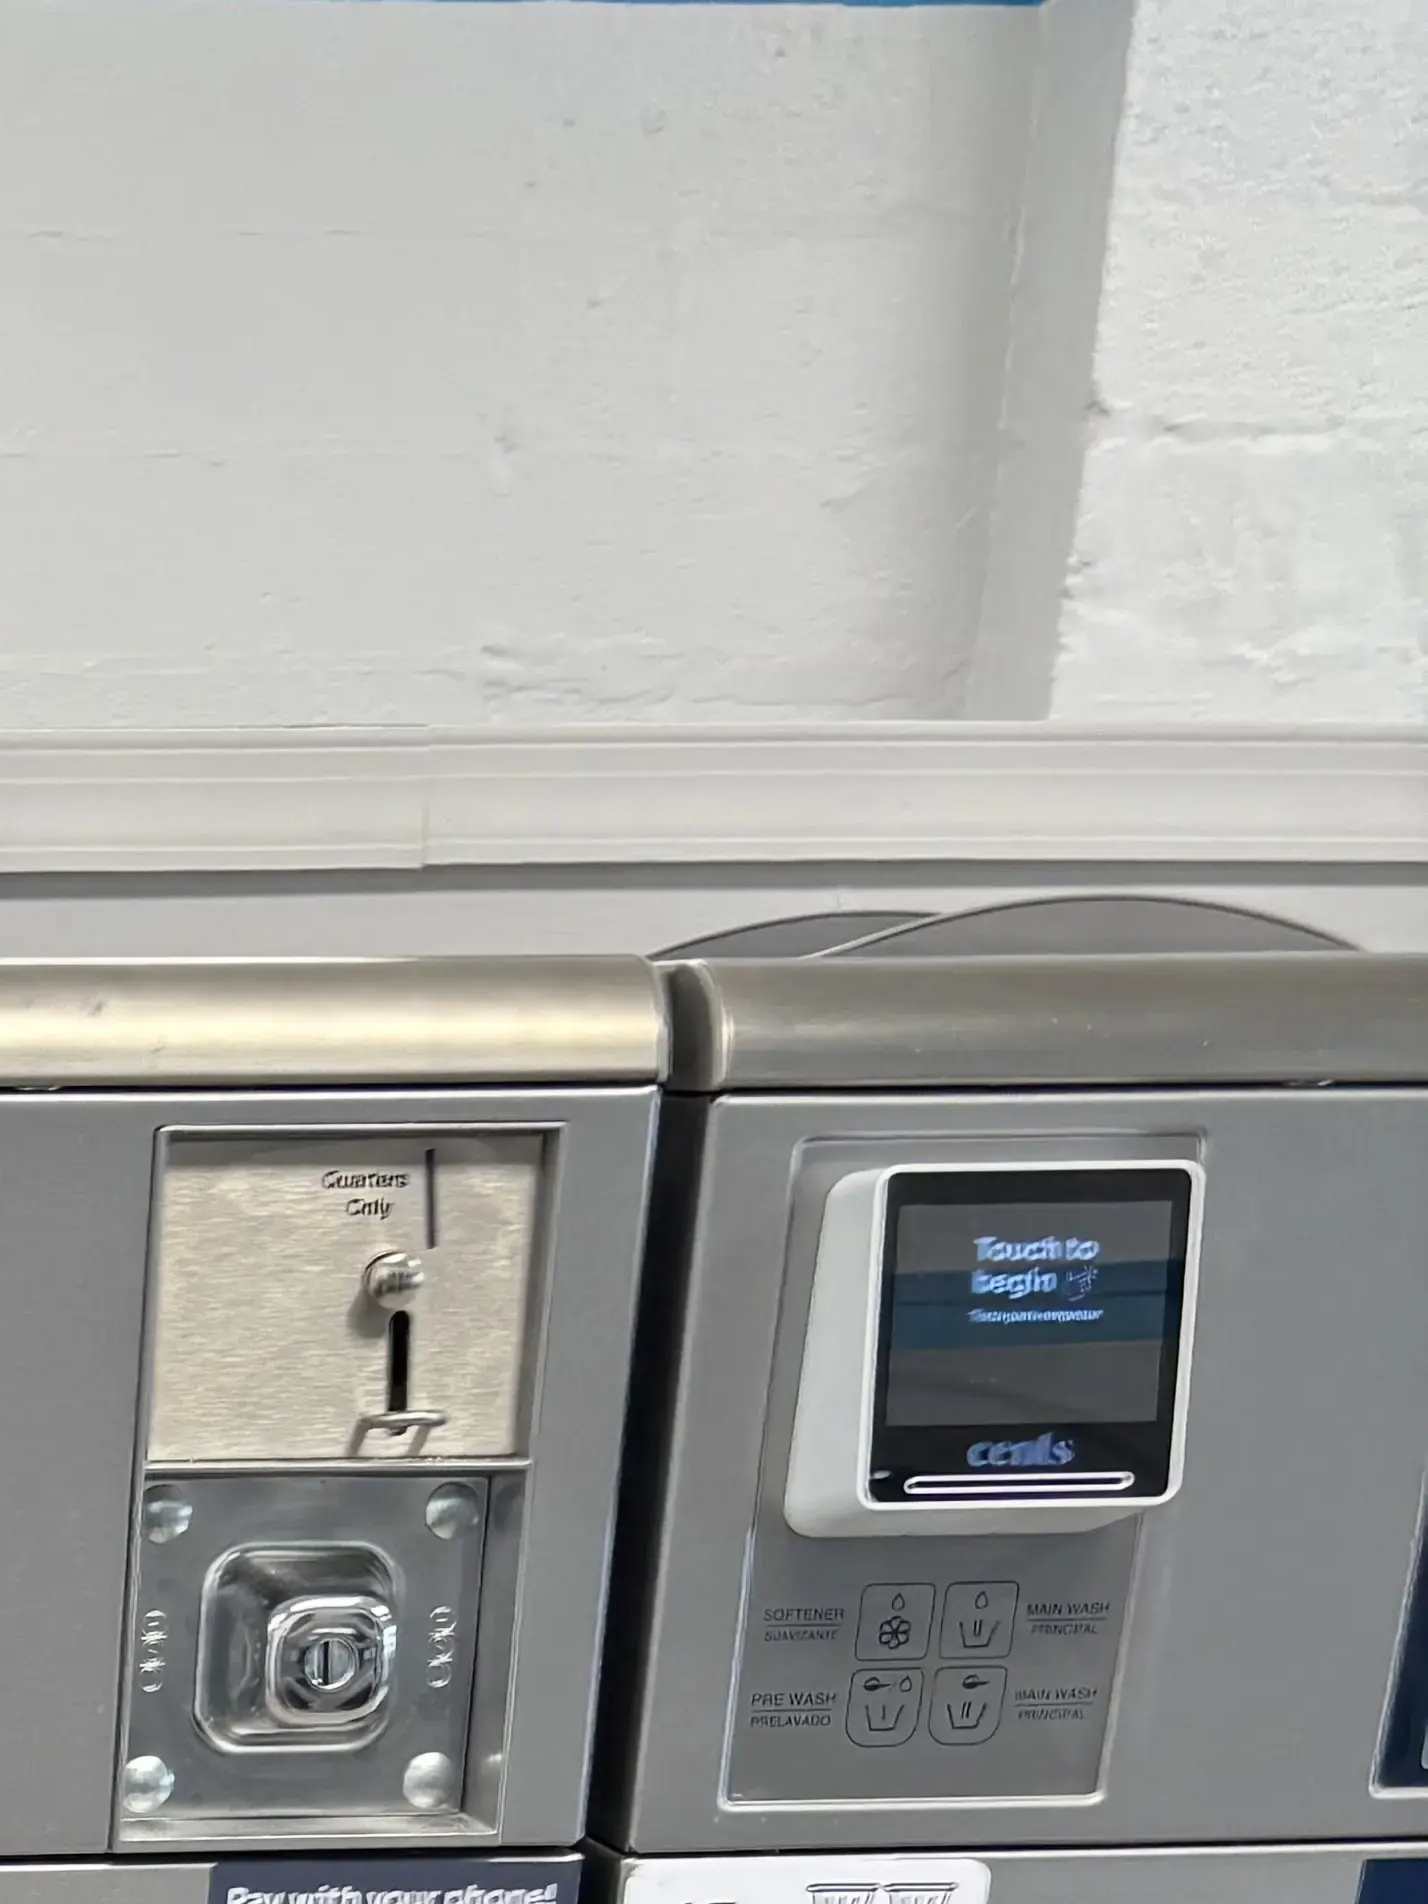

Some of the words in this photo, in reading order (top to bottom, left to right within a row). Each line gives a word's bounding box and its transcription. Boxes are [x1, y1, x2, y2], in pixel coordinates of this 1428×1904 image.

[322, 1170, 409, 1189] Quarters
[346, 1197, 395, 1220] Only
[973, 1235, 1062, 1262] Touch
[1065, 1237, 1100, 1261] to
[971, 1266, 1058, 1299] begin
[966, 1432, 1075, 1468] cents
[764, 1608, 844, 1621] SOFTENER
[1026, 1603, 1062, 1616] MAIN
[1067, 1601, 1110, 1615] WASH
[751, 1692, 784, 1706] PRE
[789, 1691, 836, 1706] WASH
[1055, 1686, 1098, 1700] WASH
[750, 1714, 831, 1728] PRELAVADO
